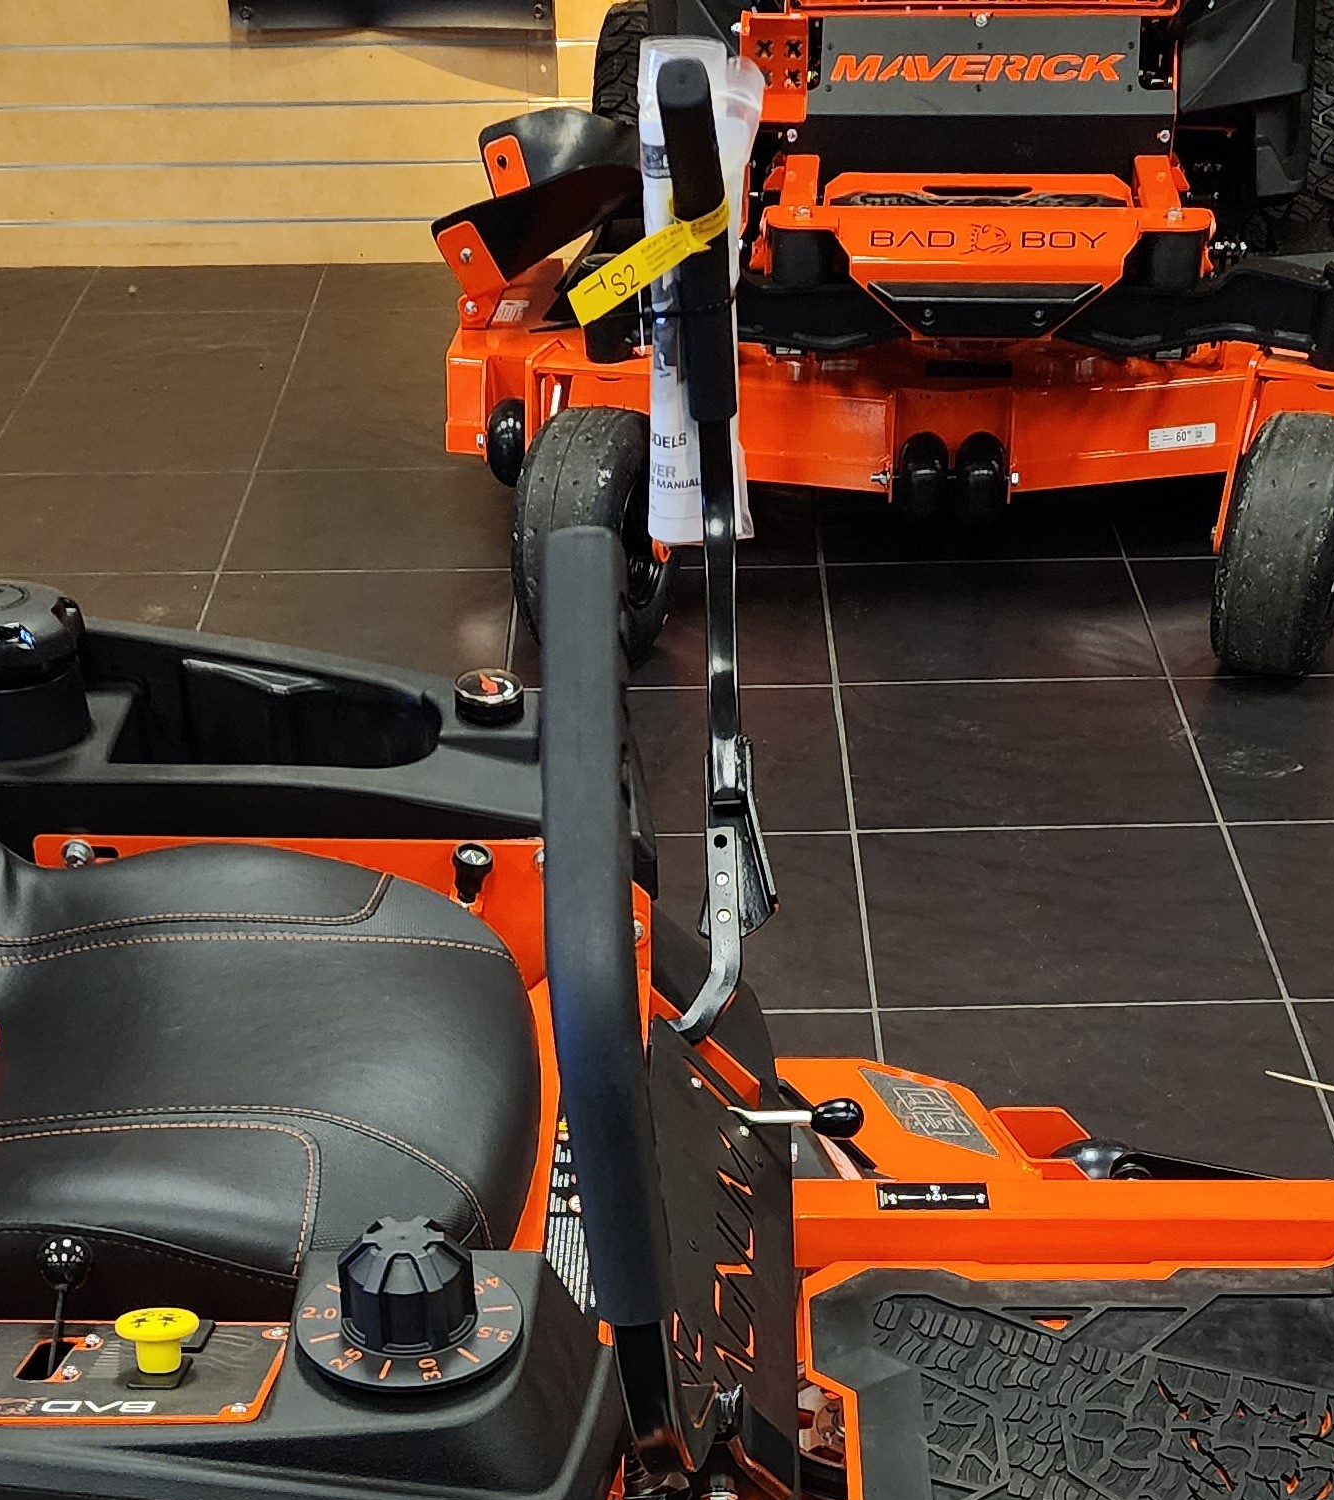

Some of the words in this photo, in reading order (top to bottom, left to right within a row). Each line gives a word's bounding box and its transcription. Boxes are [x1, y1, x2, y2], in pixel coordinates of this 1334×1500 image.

[830, 53, 1126, 82] MAVERICK
[870, 230, 955, 249] BAD
[1021, 231, 1108, 249] BOY
[651, 431, 687, 449] DELS
[657, 477, 700, 490] MANUAL
[713, 1126, 757, 1392] AGNUM
[302, 1306, 338, 1320] 2.0
[476, 1325, 513, 1343] 3.5
[328, 1347, 363, 1371] 2.5
[418, 1357, 442, 1381] 3.0
[40, 1400, 156, 1413] BAD
